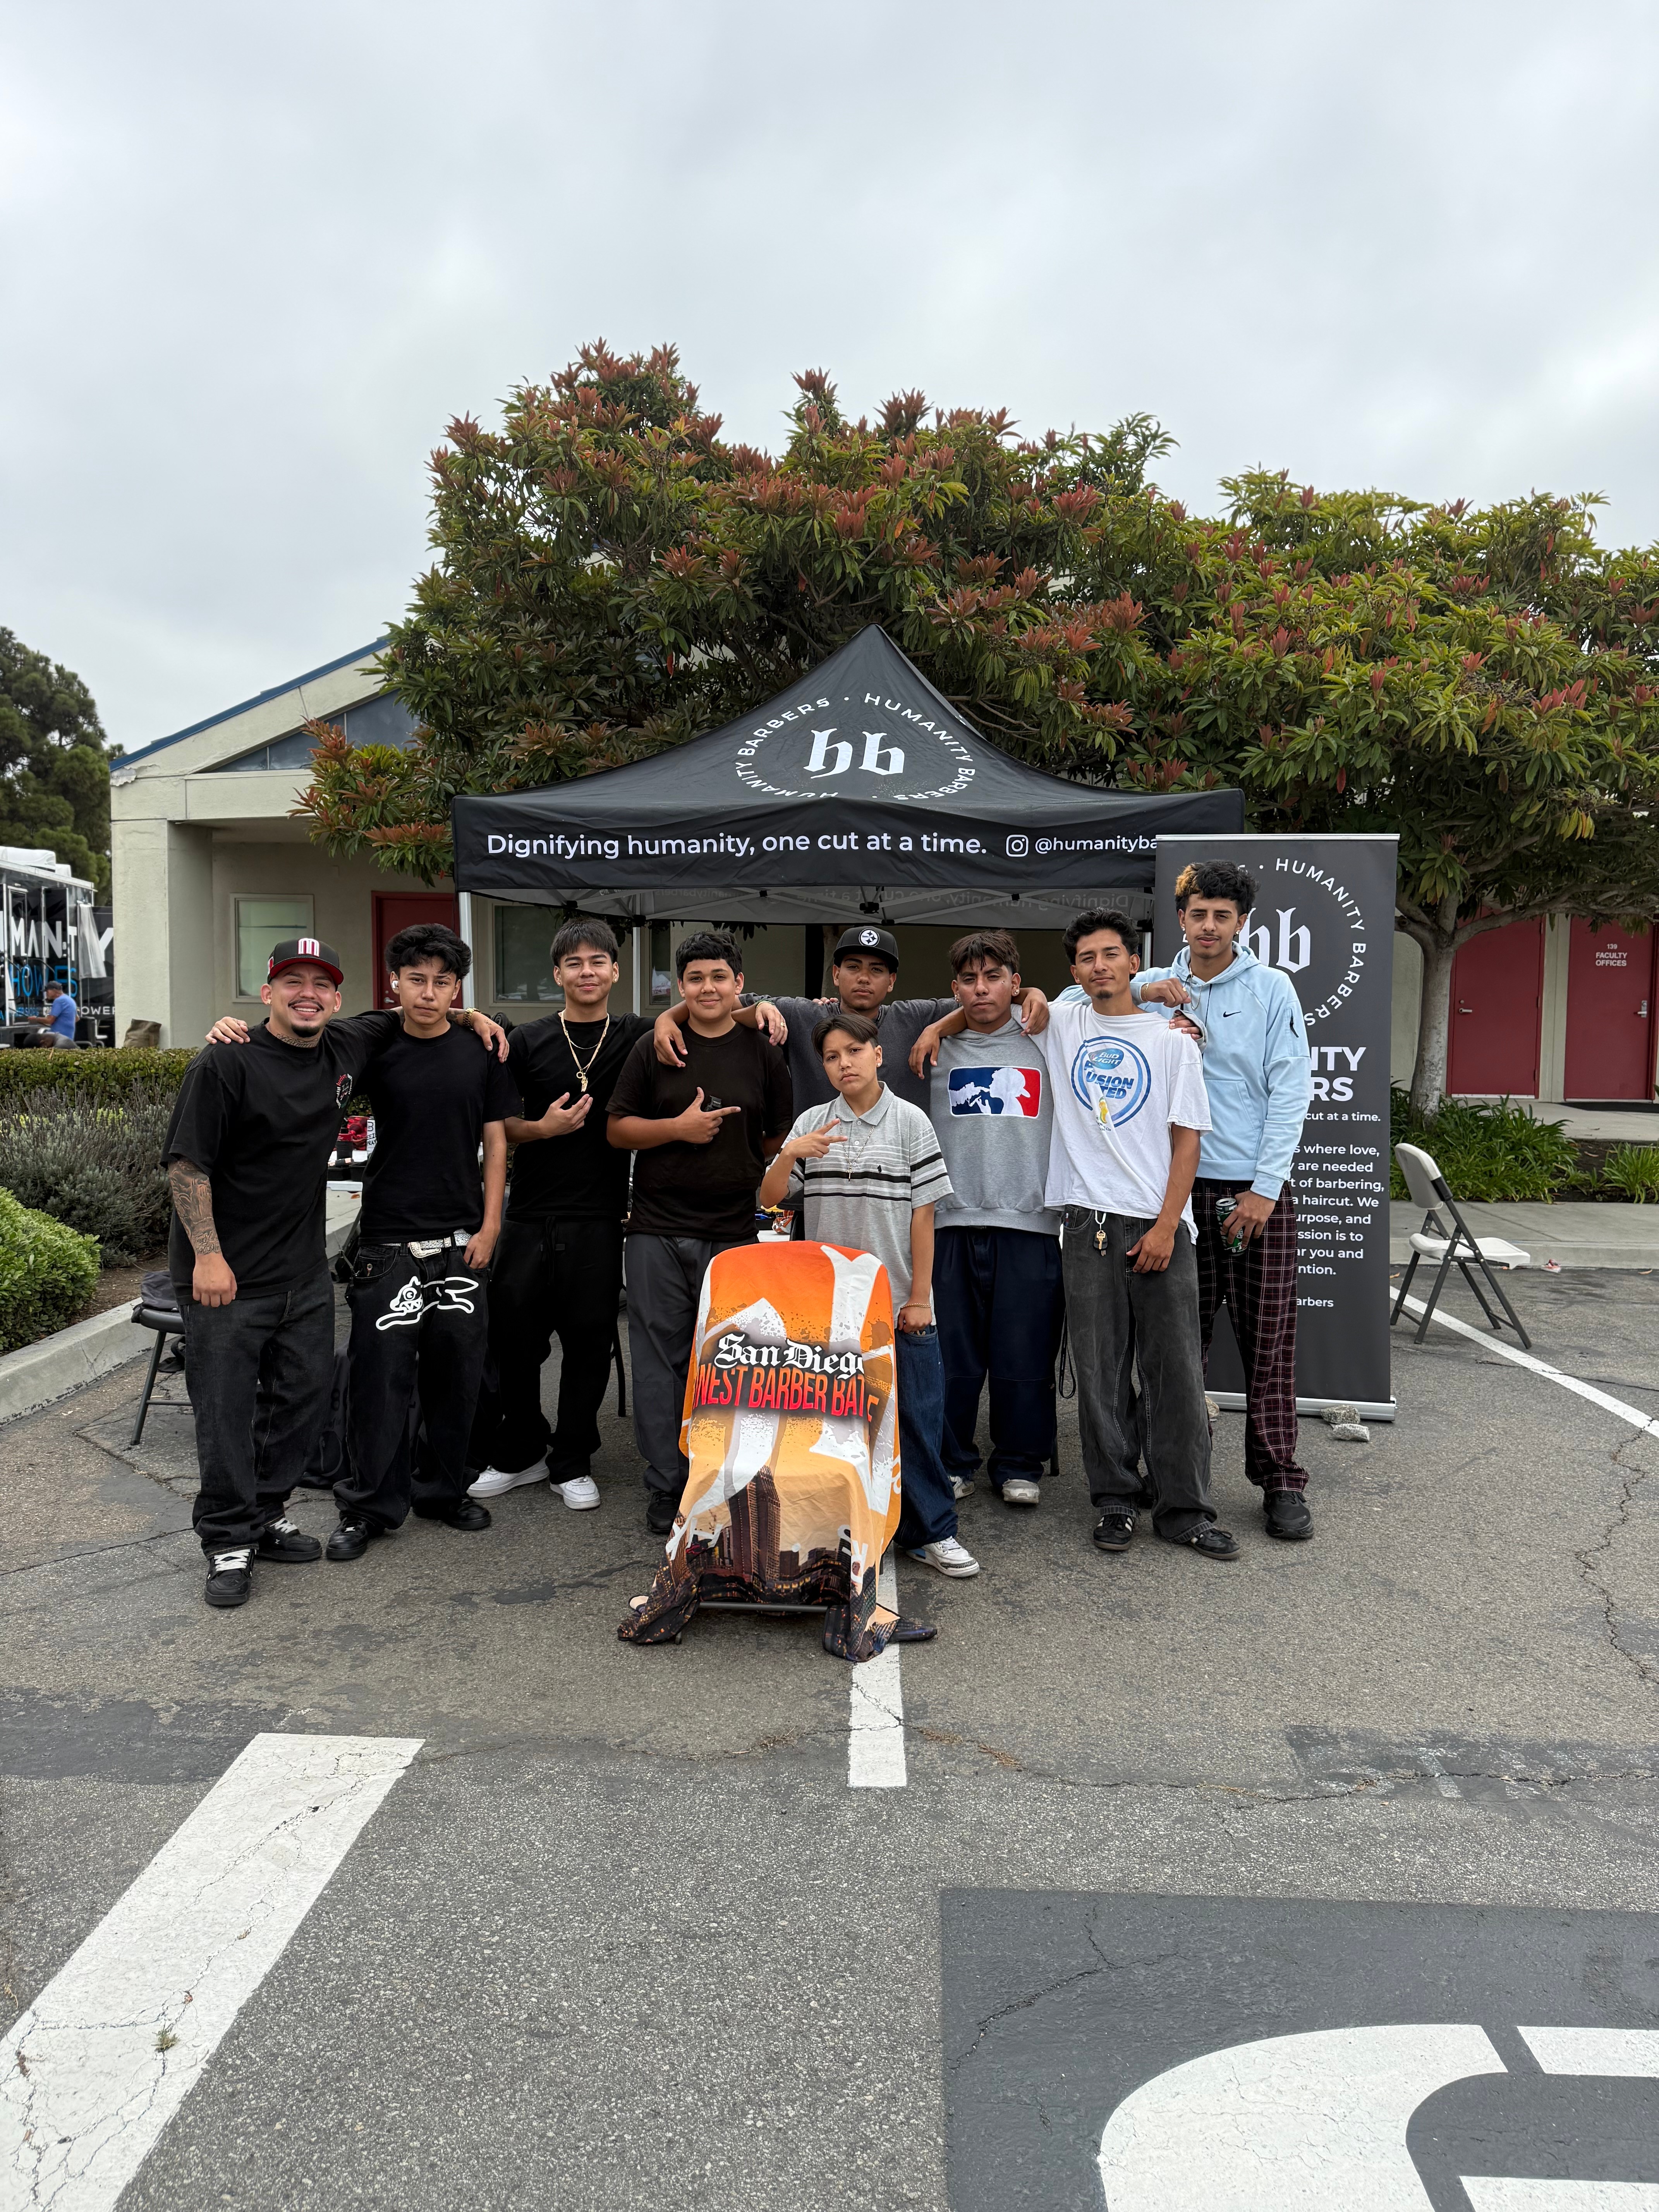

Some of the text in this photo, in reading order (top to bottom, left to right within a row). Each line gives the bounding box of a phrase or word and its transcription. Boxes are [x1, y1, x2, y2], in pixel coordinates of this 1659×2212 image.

[735, 697, 838, 798] HUMANITY BARBERS
[864, 693, 975, 800] HUMANITY BARBERS
[488, 832, 987, 859] Dignifying humanity, one cut at a time.
[1276, 858, 1366, 1026] HUMANITY BARBERS
[1092, 1056, 1121, 1065] LIGHT
[1305, 1112, 1324, 1120] cut
[1327, 1112, 1339, 1121] at
[1351, 1111, 1381, 1121] time.
[1304, 1143, 1346, 1154] where
[1350, 1144, 1379, 1157] love,
[1298, 1163, 1319, 1171] are
[1322, 1161, 1373, 1172] needed
[1299, 1178, 1313, 1188] of
[1316, 1178, 1384, 1192] barbering,
[1303, 1194, 1353, 1206] haircut.
[1357, 1197, 1379, 1207] We
[1345, 1214, 1371, 1224] and
[1297, 1229, 1364, 1242] ssion is to
[1309, 1249, 1334, 1259] you
[1338, 1249, 1364, 1259] and
[1298, 1264, 1336, 1275] ntion.
[714, 1333, 780, 1368] San
[748, 1366, 828, 1413] BARBER
